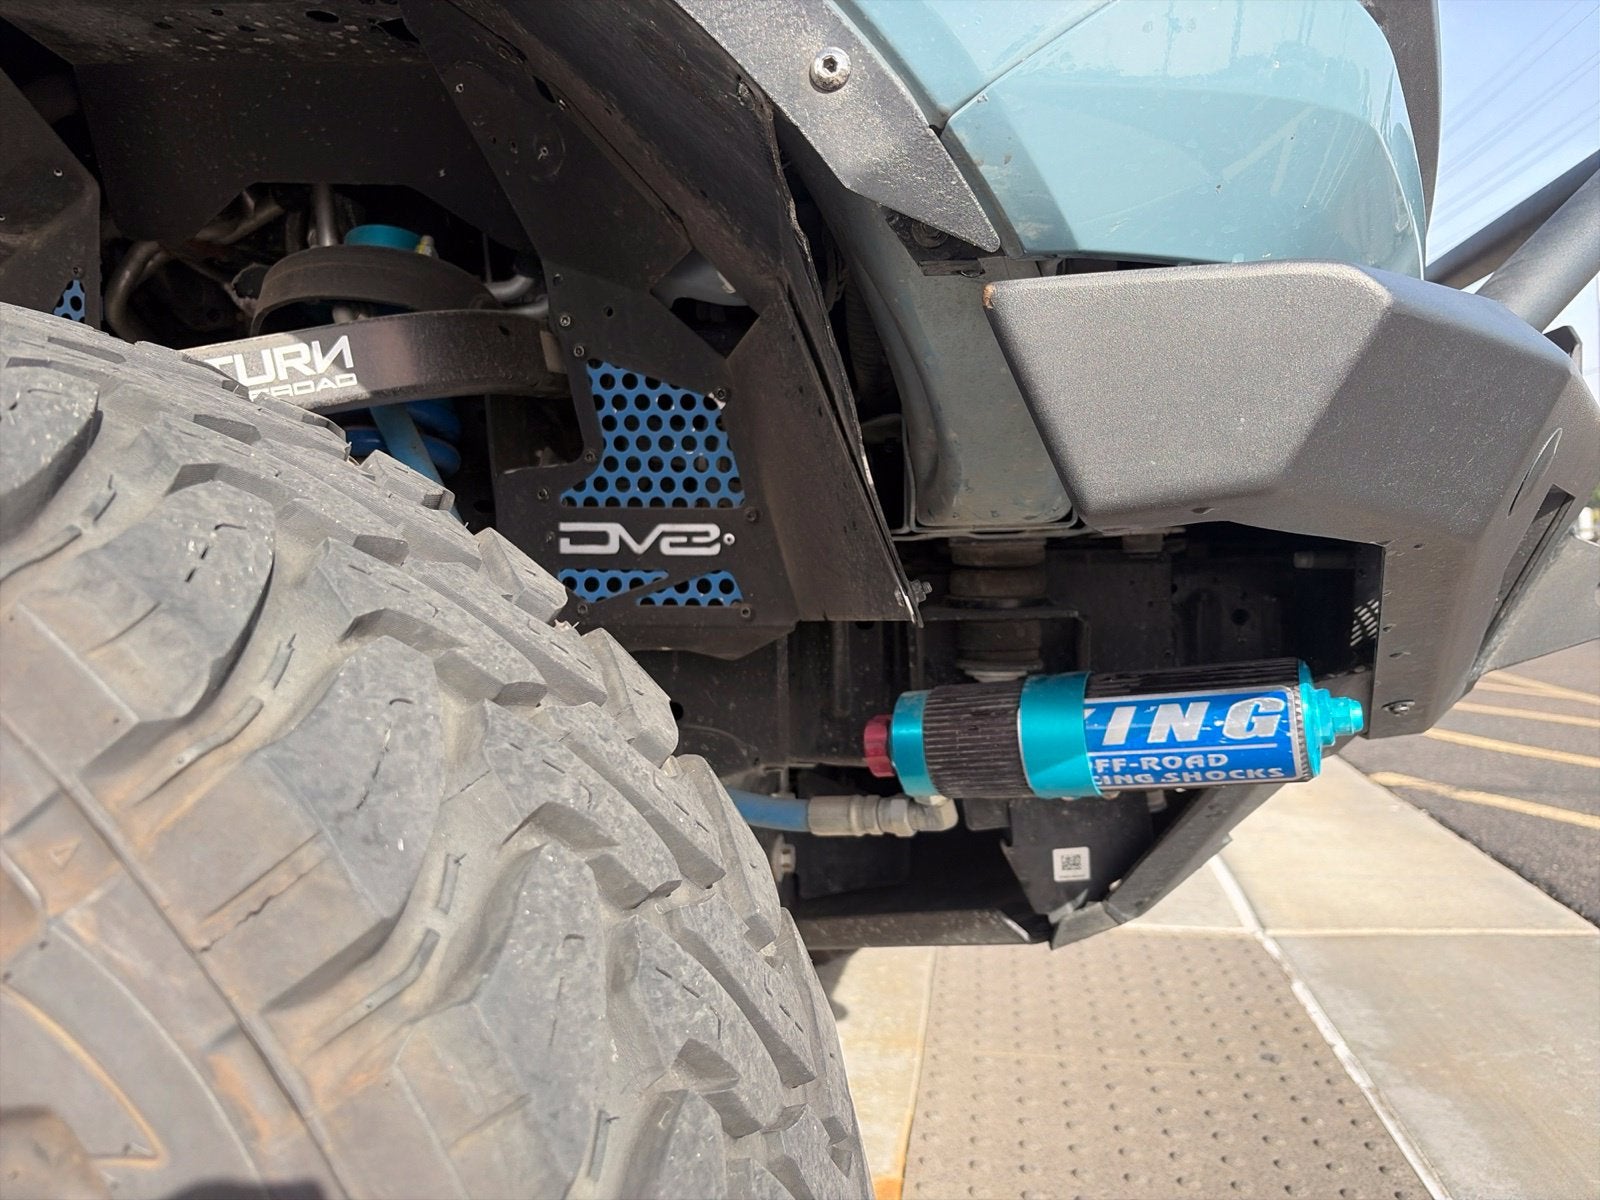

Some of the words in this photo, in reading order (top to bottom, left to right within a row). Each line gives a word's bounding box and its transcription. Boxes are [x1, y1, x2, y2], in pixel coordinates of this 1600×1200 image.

[1084, 697, 1284, 746] ING
[1089, 753, 1229, 774] FF-ROAD
[1162, 766, 1285, 783] SHOCKS
